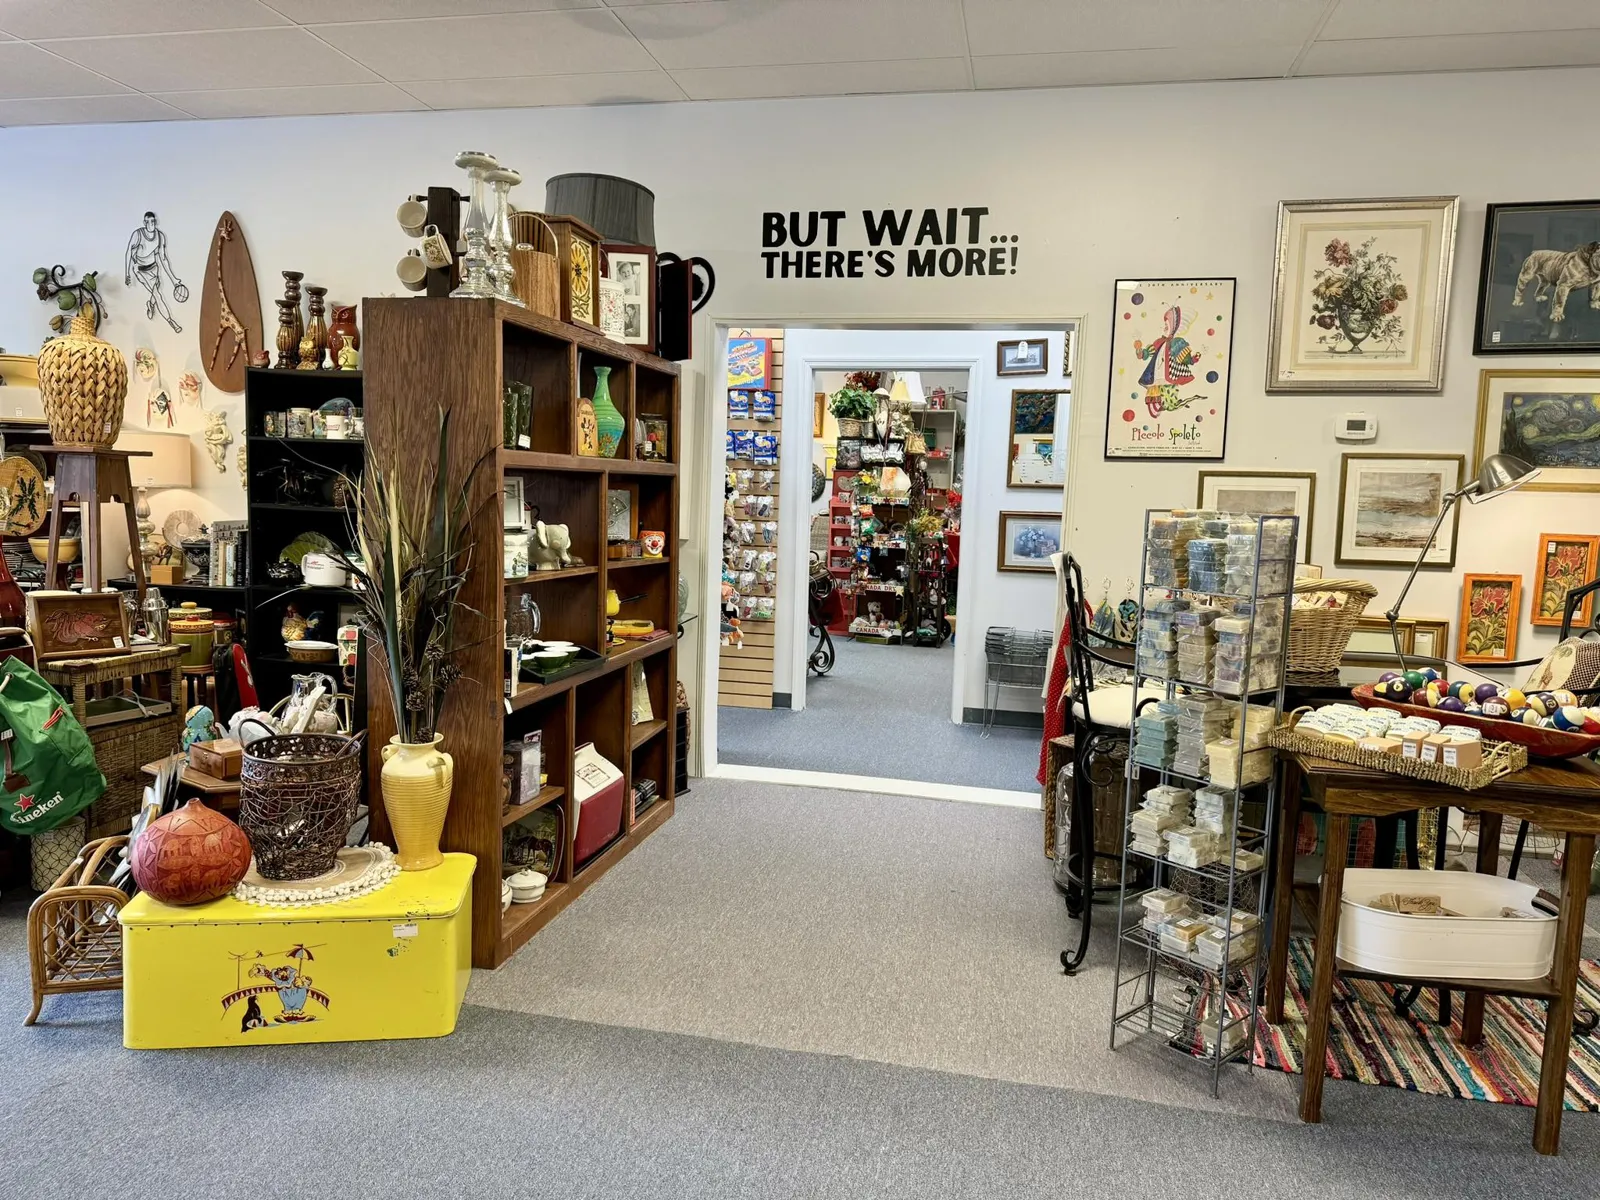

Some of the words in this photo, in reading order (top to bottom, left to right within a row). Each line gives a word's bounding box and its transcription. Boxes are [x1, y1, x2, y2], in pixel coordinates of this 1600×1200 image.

[762, 210, 846, 248] BUT
[862, 207, 1019, 247] WAIT...
[761, 249, 895, 279] THERE'S
[906, 246, 1018, 277] MORE!
[1168, 424, 1201, 445] Spoleto
